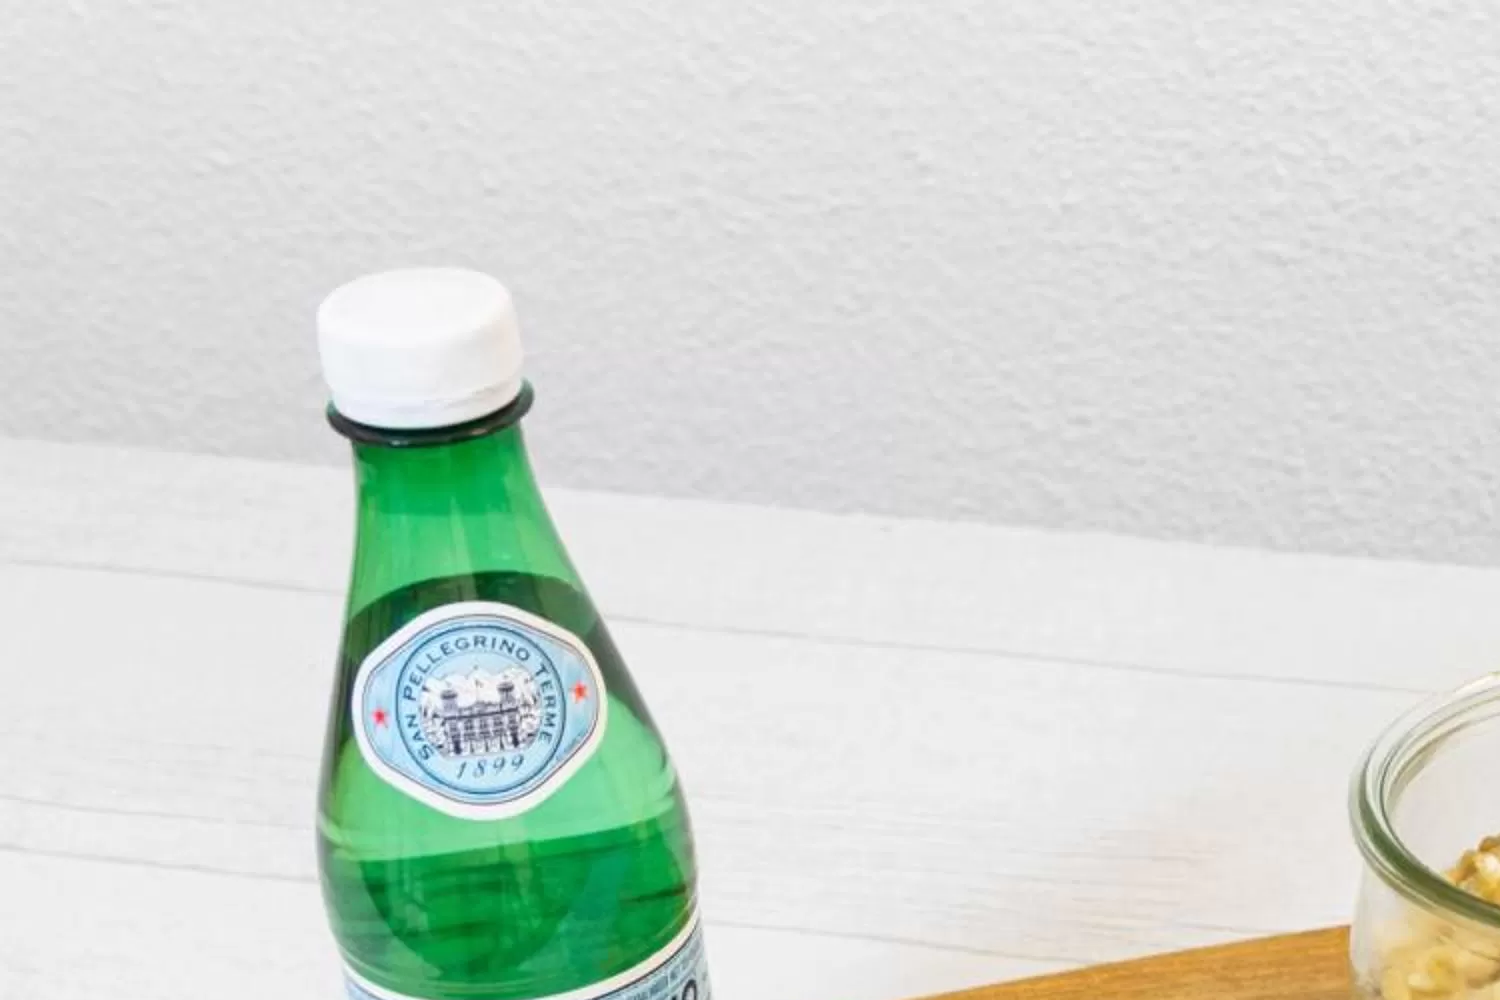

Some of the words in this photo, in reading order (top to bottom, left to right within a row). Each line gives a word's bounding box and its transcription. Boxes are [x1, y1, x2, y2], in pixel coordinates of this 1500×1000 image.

[403, 634, 531, 702] PELLEGRINO
[535, 663, 558, 744] TERME
[407, 714, 435, 762] SAN
[456, 754, 525, 780] 1899
